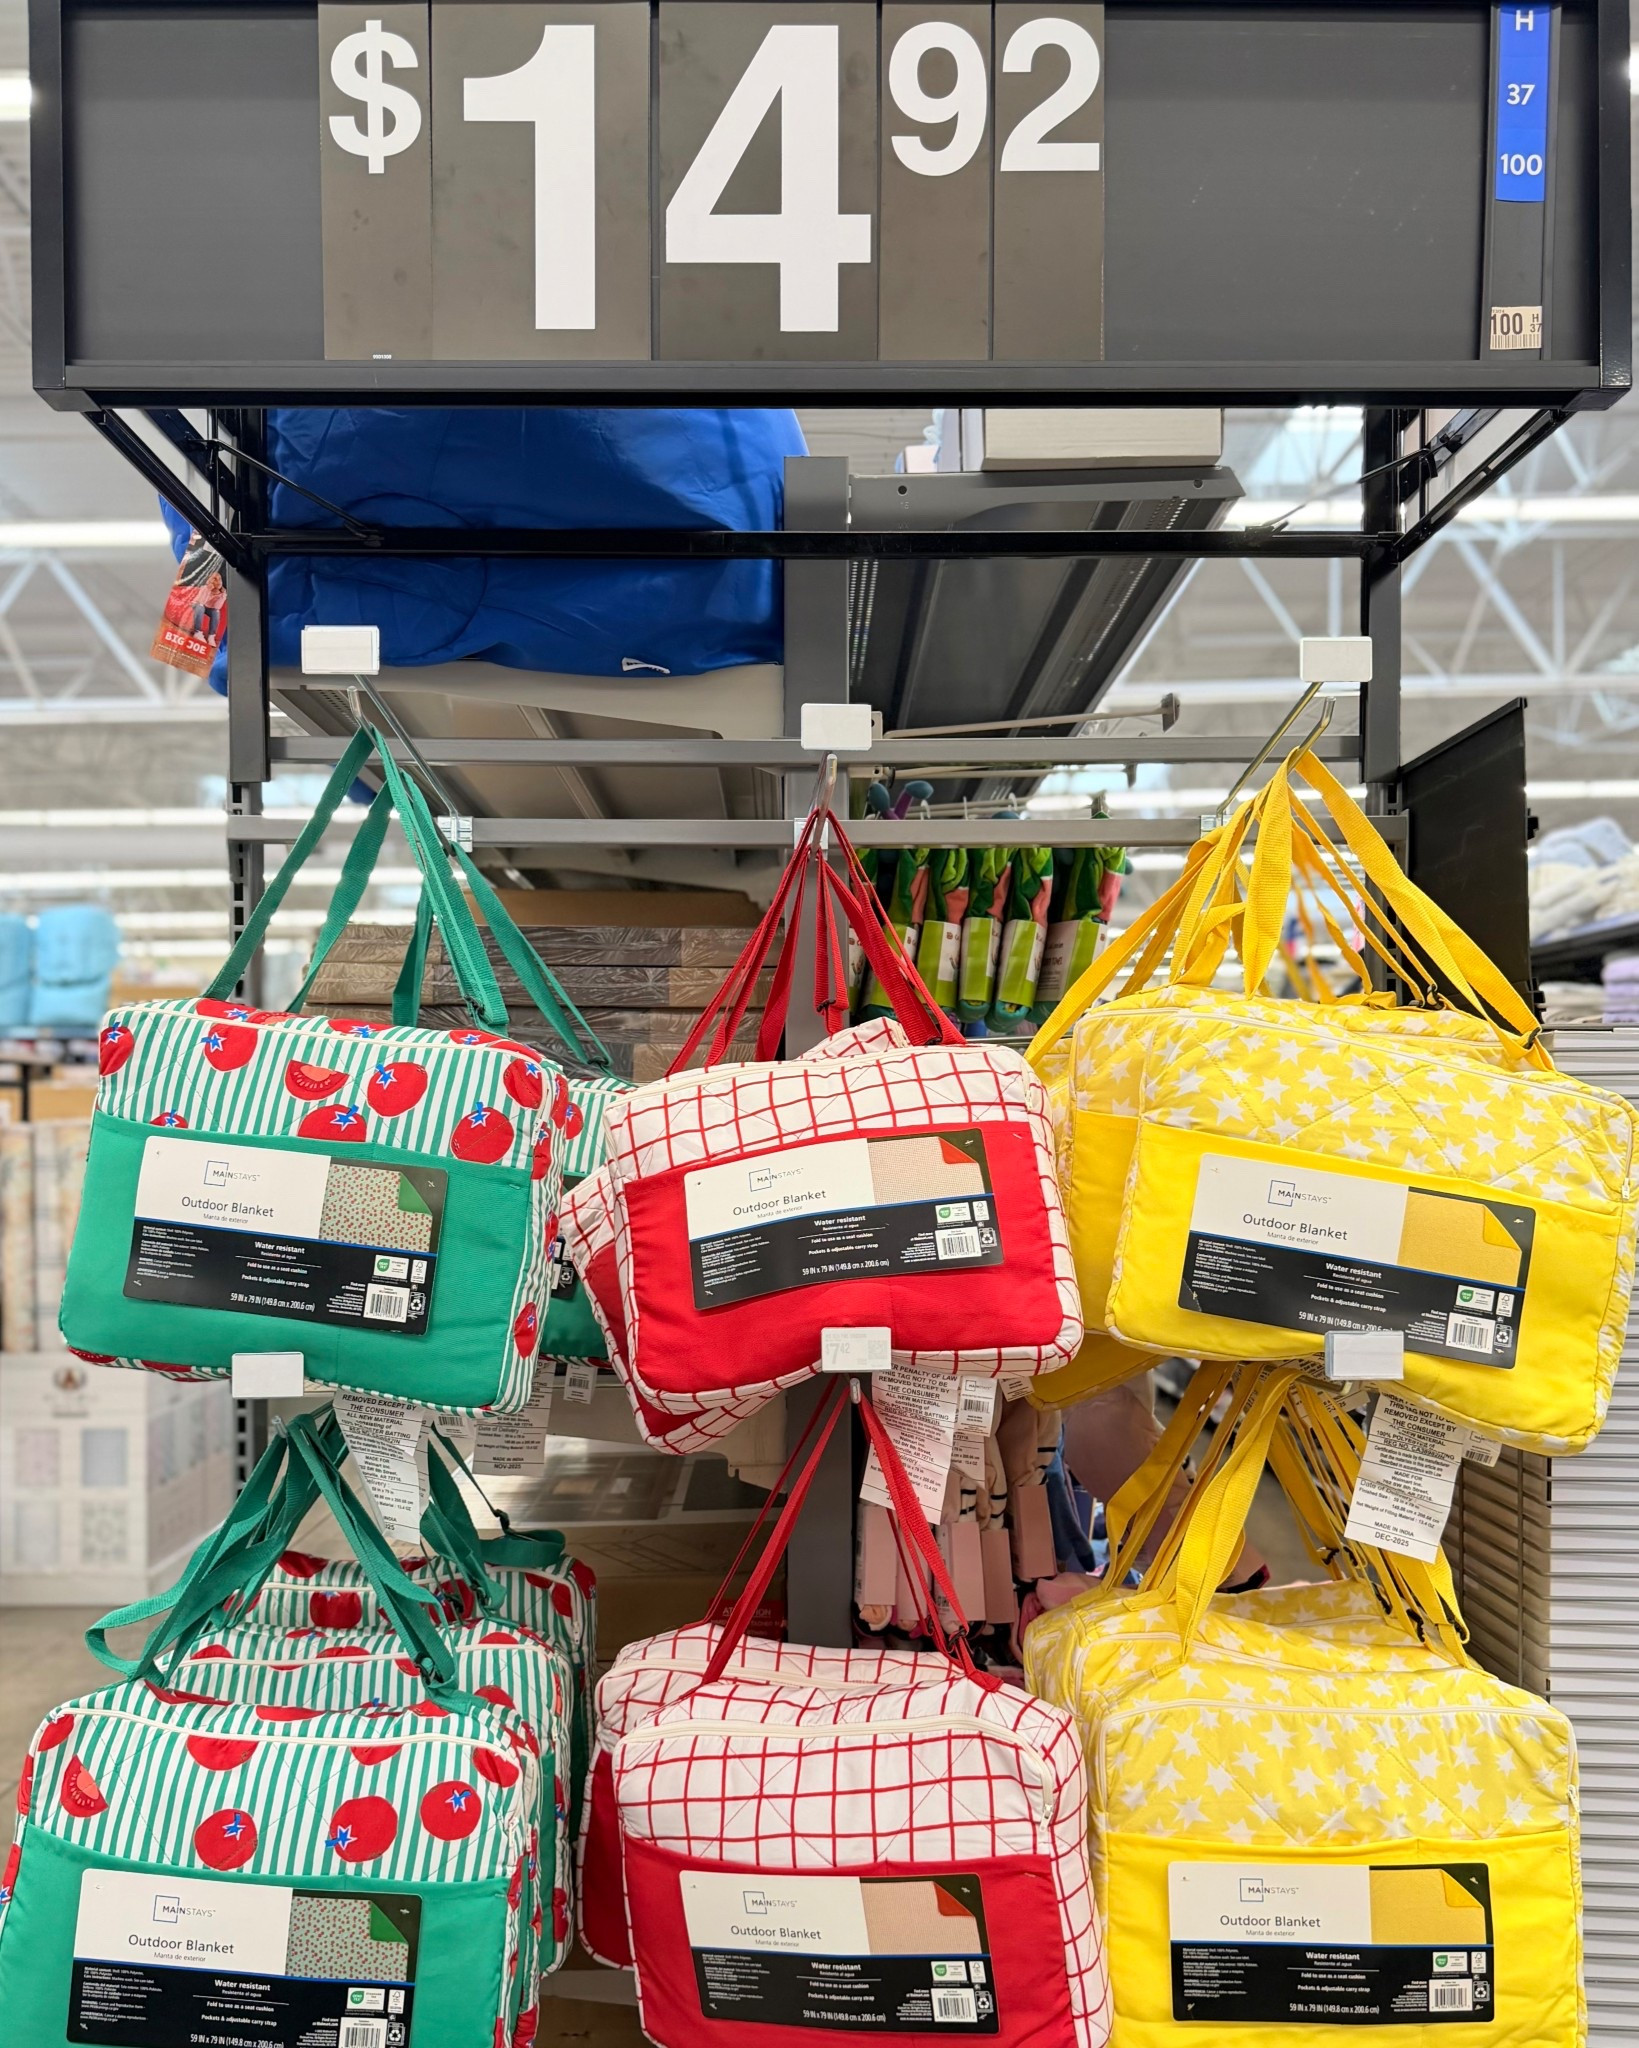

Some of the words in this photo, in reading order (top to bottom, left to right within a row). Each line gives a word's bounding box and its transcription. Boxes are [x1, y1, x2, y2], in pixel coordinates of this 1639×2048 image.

[1515, 10, 1533, 31] H
[1506, 83, 1535, 106] 37
[1500, 153, 1542, 176] 100
[1490, 312, 1523, 336] 100
[1532, 313, 1539, 323] H
[1529, 323, 1543, 333] 37
[164, 631, 185, 646] BIG
[186, 638, 207, 655] JOE
[212, 1170, 257, 1182] MAINSTAYS
[757, 1169, 801, 1183] MAINSTAYS
[733, 1199, 780, 1216] Outdoor
[783, 1190, 827, 1205] Blanket
[1277, 1189, 1328, 1204] MAINSTAYS
[181, 1196, 228, 1211] Outdoor
[231, 1202, 274, 1217] Blanket
[203, 1213, 220, 1221] Manta
[837, 1215, 866, 1223] resistant
[1243, 1213, 1296, 1231] Outdoor
[1299, 1223, 1348, 1241] Blanket
[1267, 1231, 1286, 1240] Manta
[1296, 1237, 1319, 1245] exterior
[254, 1241, 274, 1250] Water
[276, 1245, 305, 1254] resistant
[1326, 1262, 1349, 1273] Water
[1350, 1267, 1382, 1279] resistant
[230, 1292, 237, 1301] 59
[238, 1293, 244, 1302] IN
[248, 1295, 255, 1303] 79
[255, 1296, 261, 1304] IN
[262, 1296, 278, 1306] (149.8
[290, 1301, 305, 1310] 200.6
[305, 1303, 315, 1312] cm)
[1298, 1311, 1307, 1320] 59
[1307, 1312, 1314, 1321] IN
[1319, 1315, 1326, 1324] 79
[1327, 1316, 1334, 1325] IN
[1334, 1317, 1352, 1328] (149.8
[1352, 1321, 1361, 1329] cm
[900, 1365, 930, 1377] PENALTY
[931, 1371, 940, 1379] OF
[942, 1374, 957, 1382] LAW
[878, 1375, 911, 1386] REMOVED
[913, 1382, 939, 1391] EXCEPT
[887, 1384, 900, 1392] THE
[901, 1387, 940, 1399] CONSUMER
[342, 1394, 377, 1405] REMOVED
[377, 1400, 406, 1409] EXCEPT
[912, 1398, 940, 1407] MATERIAL
[350, 1403, 364, 1411] THE
[364, 1406, 405, 1418] CONSUMER
[1389, 1400, 1405, 1410] THIS
[1419, 1410, 1434, 1419] NOT
[374, 1417, 404, 1426] MATERIAL
[1384, 1408, 1418, 1422] REMOVED
[1419, 1417, 1446, 1430] EXCEPT
[1446, 1425, 1457, 1433] BY
[1392, 1418, 1406, 1428] THE
[1407, 1422, 1446, 1438] CONSUMER
[1391, 1476, 1412, 1486] Walmart
[1374, 1521, 1392, 1531] MADE
[1399, 1527, 1415, 1537] INDIA
[1374, 1531, 1410, 1547] DEC-2025
[1248, 1886, 1296, 1894] MAINSTAYS
[751, 1899, 796, 1907] MAINSTAYS
[162, 1905, 213, 1917] MAINSTAYS
[1220, 1914, 1271, 1926] Outdoor
[1275, 1916, 1321, 1927] Blanket
[730, 1925, 776, 1937] Outdoor
[779, 1927, 822, 1940] Blanket
[128, 1934, 182, 1949] Outdoor
[186, 1939, 234, 1954] Blanket
[1305, 1951, 1328, 1959] Water
[811, 1962, 831, 1970] Water
[832, 1963, 861, 1971] resistant
[214, 1979, 237, 1988] Water
[239, 1982, 271, 1991] resistant
[1289, 2003, 1296, 2011] 59
[1297, 2003, 1304, 2011] IN
[1308, 2004, 1316, 2012] 79
[1316, 2004, 1323, 2012] IN
[1324, 2004, 1340, 2013] (149.8
[1354, 2005, 1369, 2014] 200.6
[1369, 2005, 1380, 2014] cm)
[190, 2034, 198, 2043] 59
[198, 2034, 205, 2043] IN
[210, 2036, 218, 2044] 79
[219, 2036, 225, 2045] IN
[226, 2036, 243, 2047] (149.8
[257, 2040, 273, 2048] 200.6
